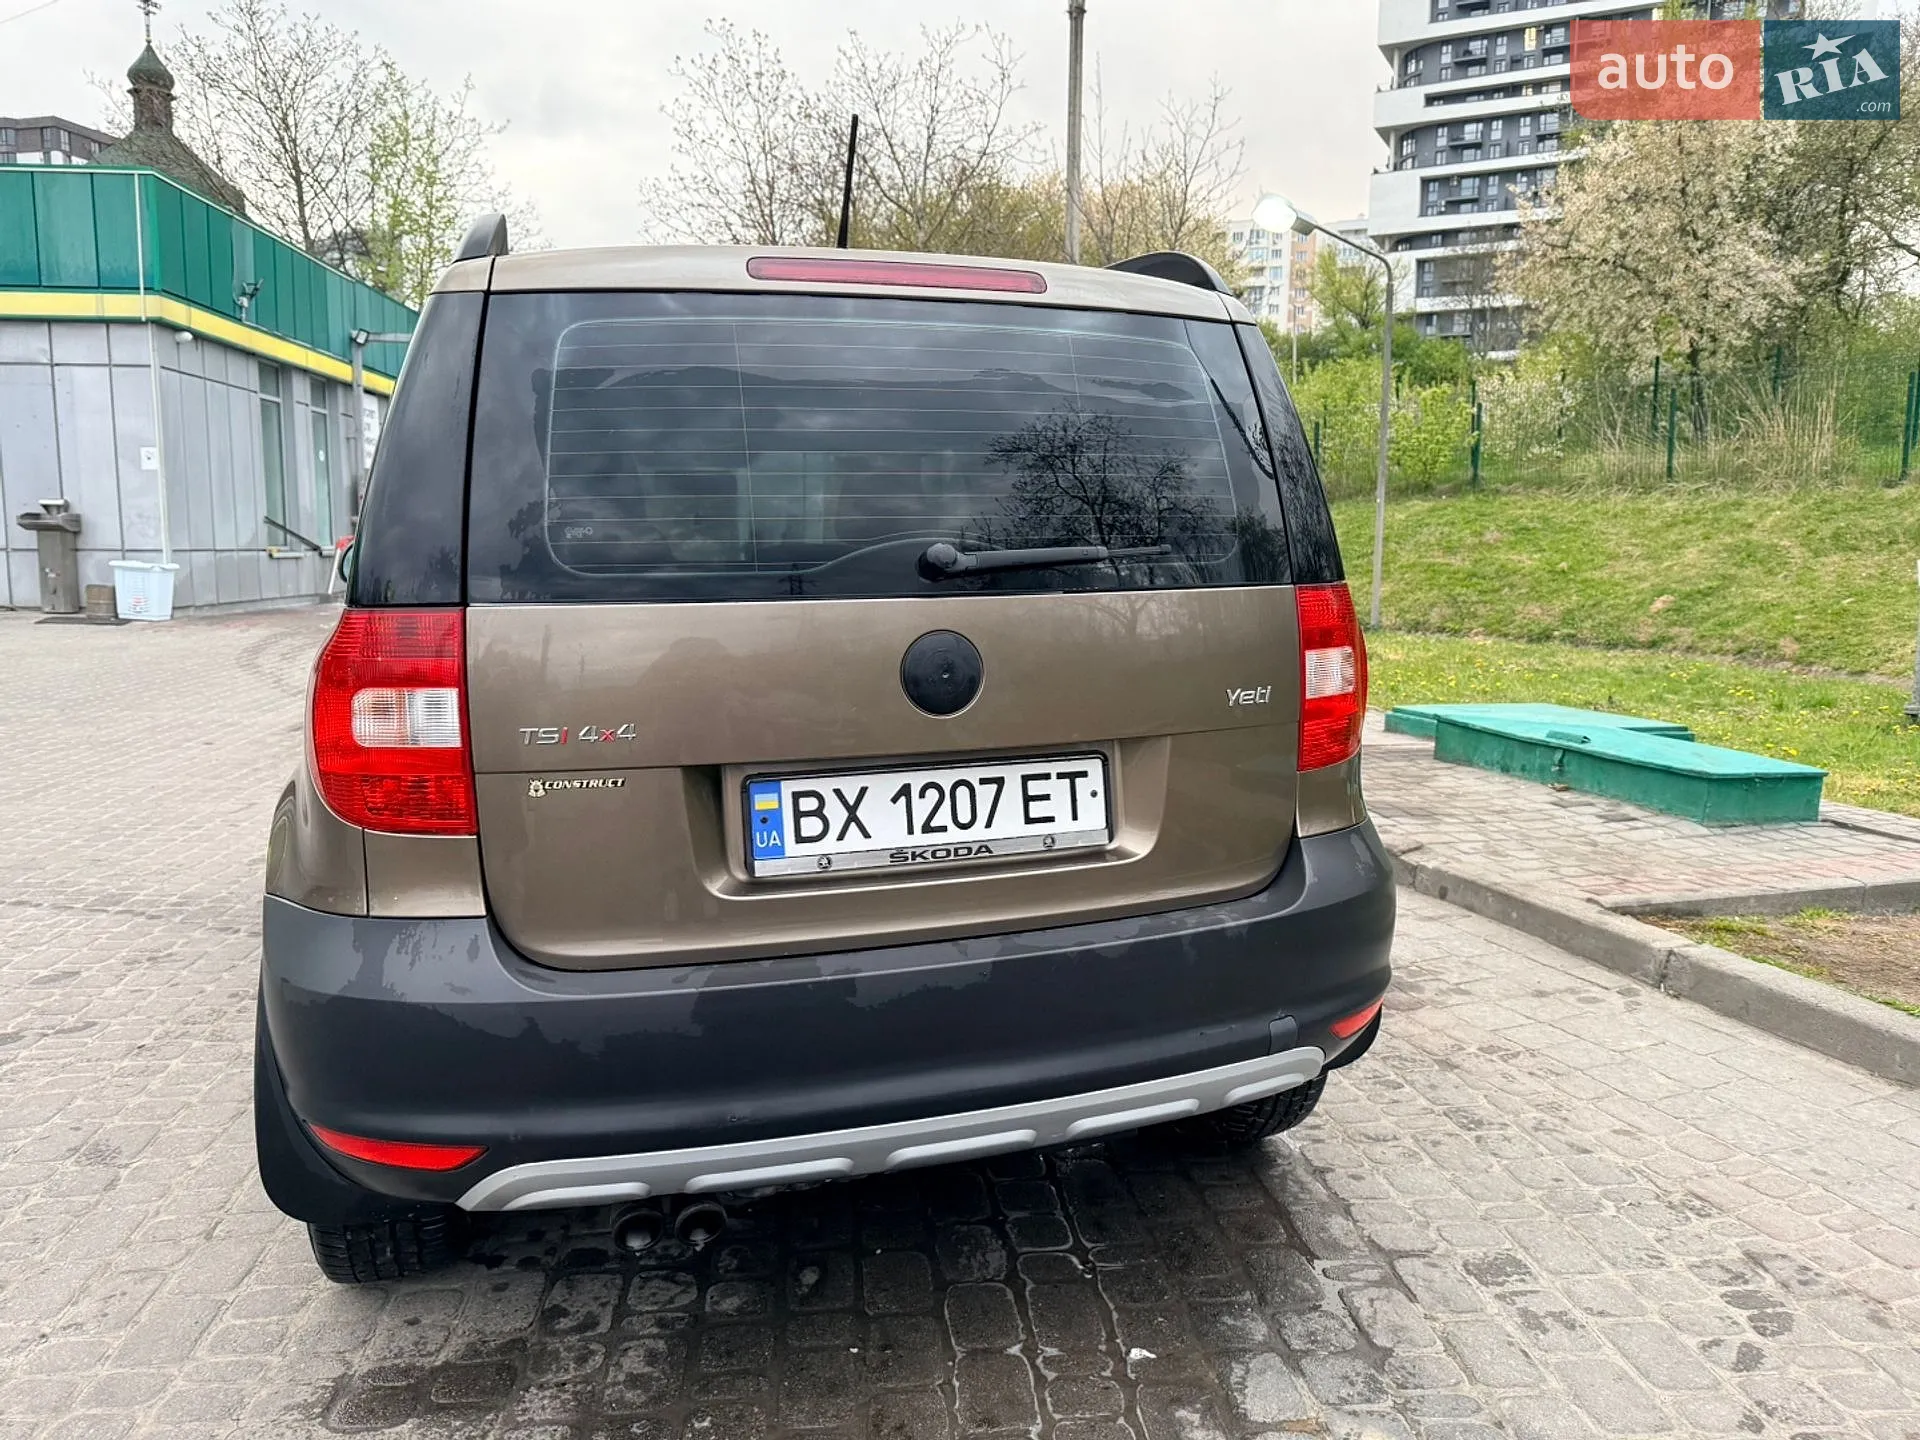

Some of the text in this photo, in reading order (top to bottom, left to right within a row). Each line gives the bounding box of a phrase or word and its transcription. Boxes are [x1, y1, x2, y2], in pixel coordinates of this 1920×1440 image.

[1226, 685, 1272, 706] Yeti
[578, 723, 636, 742] 4x4
[544, 778, 625, 790] CONSTRUCT
[791, 770, 1089, 844] BX 1207 ET
[756, 830, 782, 847] UA
[889, 844, 994, 863] ŠKODA
